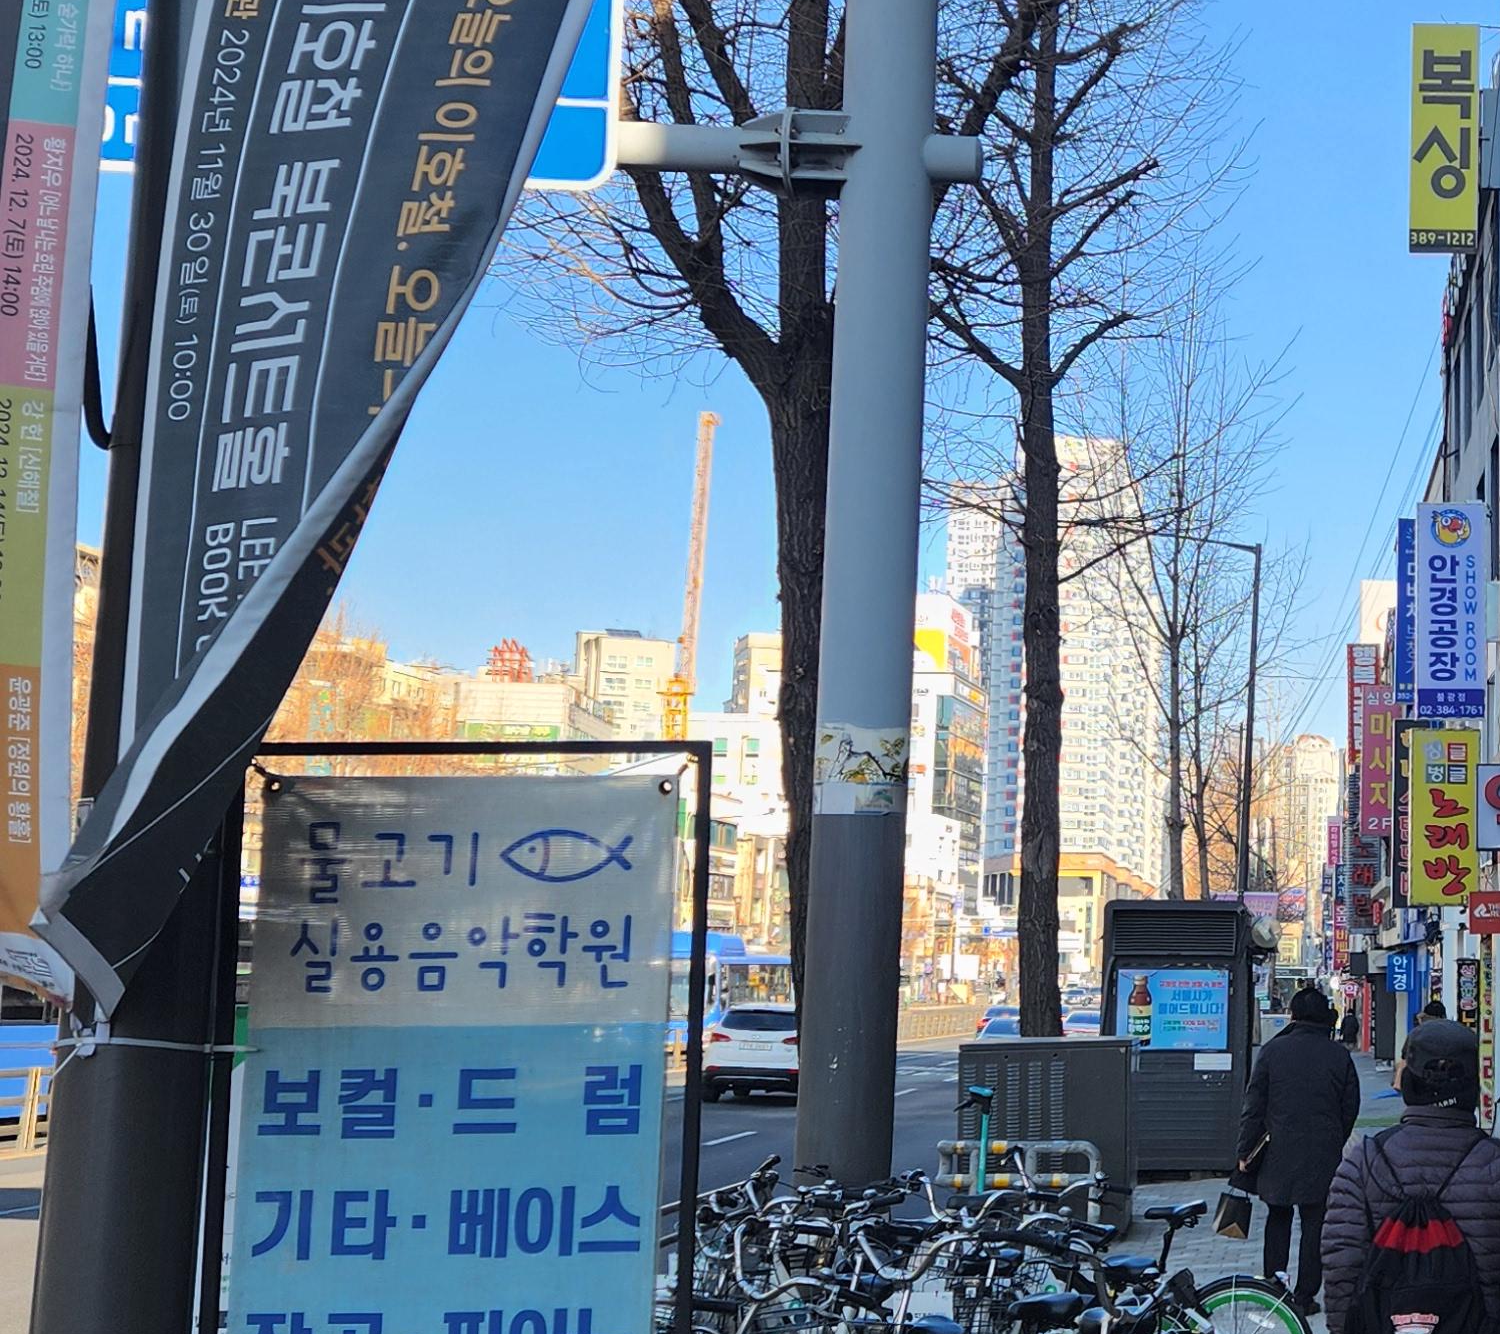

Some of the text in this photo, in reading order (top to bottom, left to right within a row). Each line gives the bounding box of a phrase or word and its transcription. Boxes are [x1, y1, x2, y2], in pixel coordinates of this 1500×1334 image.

[23, 24, 46, 69] 13:00
[54, 2, 79, 50] 숟가락
[201, 29, 249, 132] 2024년
[42, 137, 67, 186] 황지우
[191, 142, 227, 200] 11월
[396, 102, 479, 250] 이호철.
[0, 133, 34, 317] 2024. 12. 7(토) 14:00
[1410, 230, 1475, 247] 389-1212
[211, 159, 340, 493] 북콘서트홀
[168, 333, 201, 420] 10:00
[18, 446, 39, 514] [신해철]
[196, 523, 235, 620] BOOK
[1428, 555, 1460, 681] 안경공장
[1464, 555, 1477, 681] SHOW ROOM
[7, 677, 32, 732] 윤광준
[1368, 711, 1392, 807] 마사지
[308, 821, 478, 905] 물고기
[1368, 818, 1391, 830] 2F
[1424, 788, 1471, 896] 노래방
[290, 913, 633, 994] 실용음악학원
[1393, 955, 1408, 991] 안경
